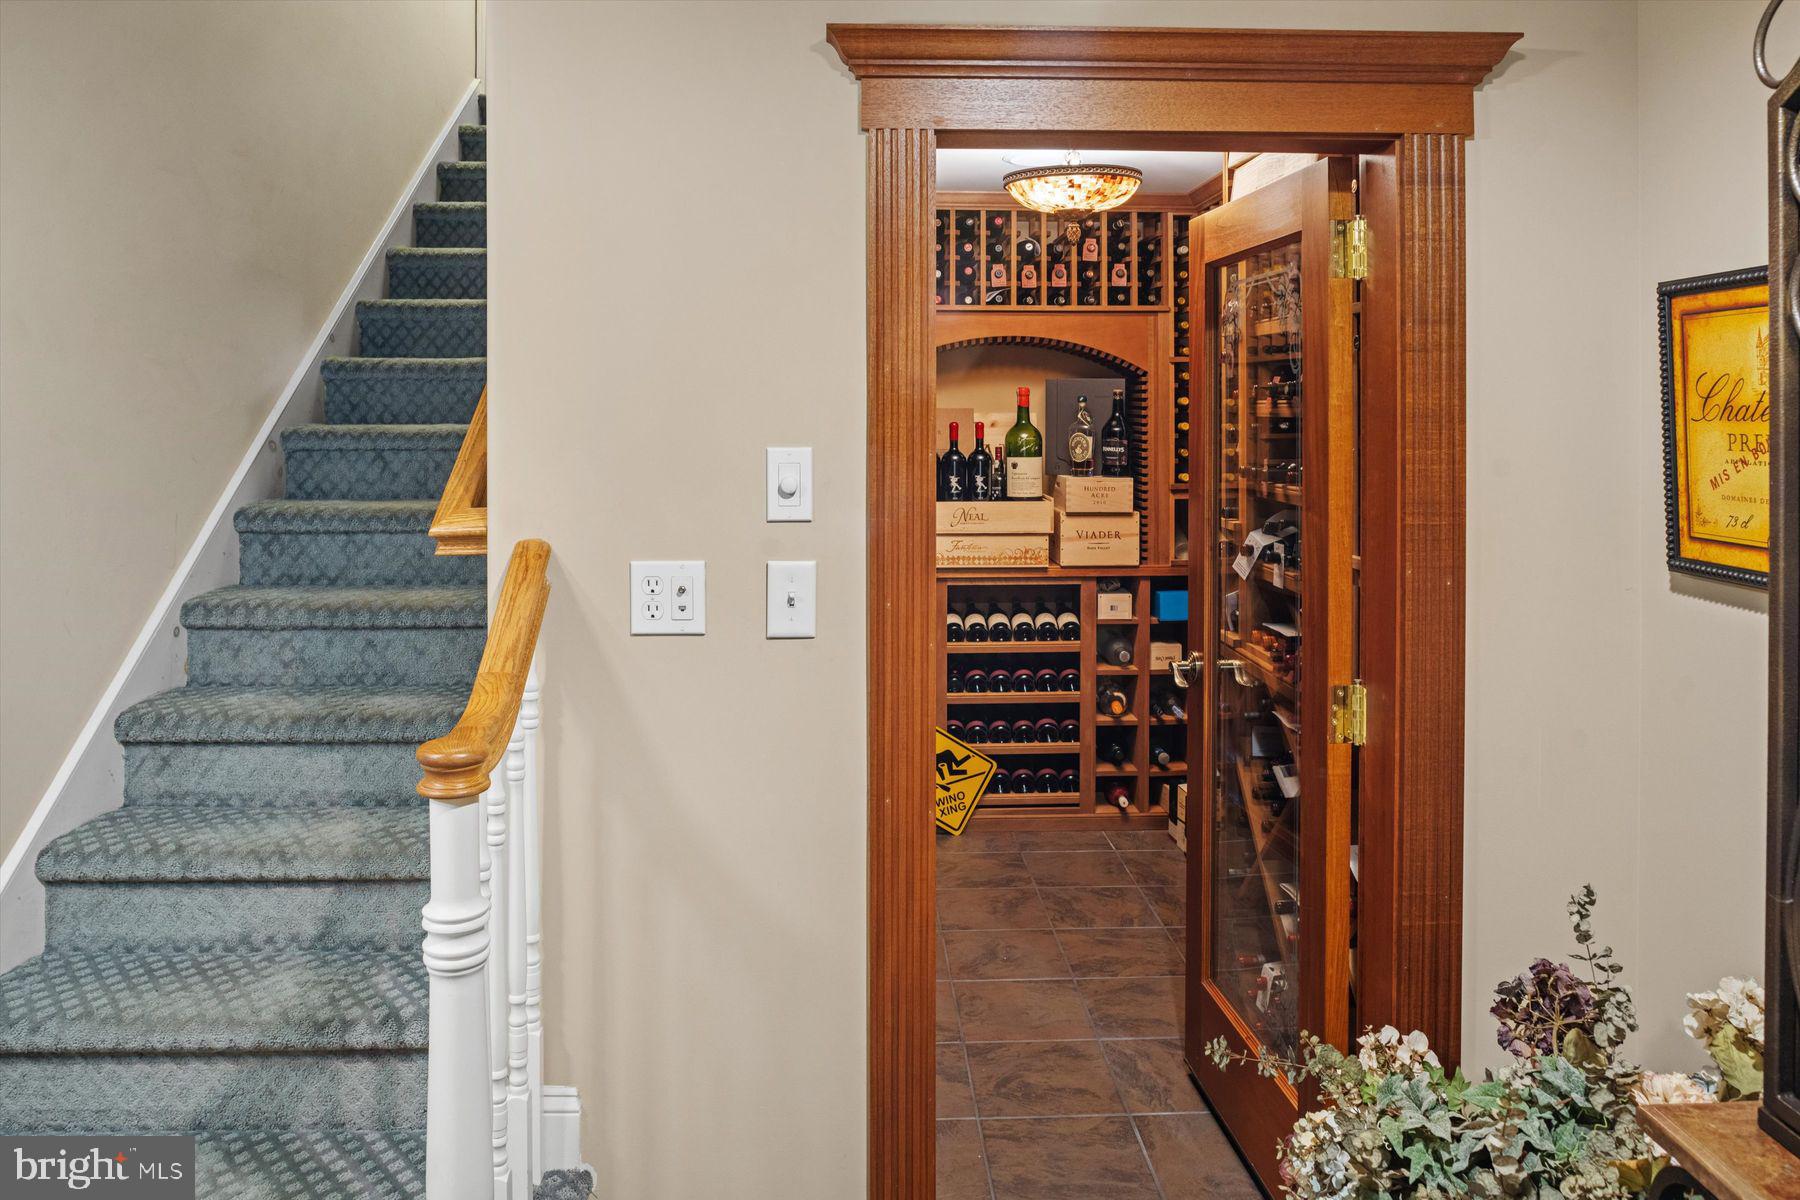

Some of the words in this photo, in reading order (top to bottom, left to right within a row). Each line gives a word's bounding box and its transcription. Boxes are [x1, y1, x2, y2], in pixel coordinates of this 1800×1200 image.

[1727, 433, 1769, 452] PRE
[1709, 469, 1730, 490] MIS
[1733, 455, 1749, 474] EN
[1751, 439, 1769, 461] BO
[1721, 494, 1757, 504] DOMAINES
[1076, 530, 1122, 540] VIADER
[936, 791, 965, 807] WINO
[939, 802, 967, 817] XING
